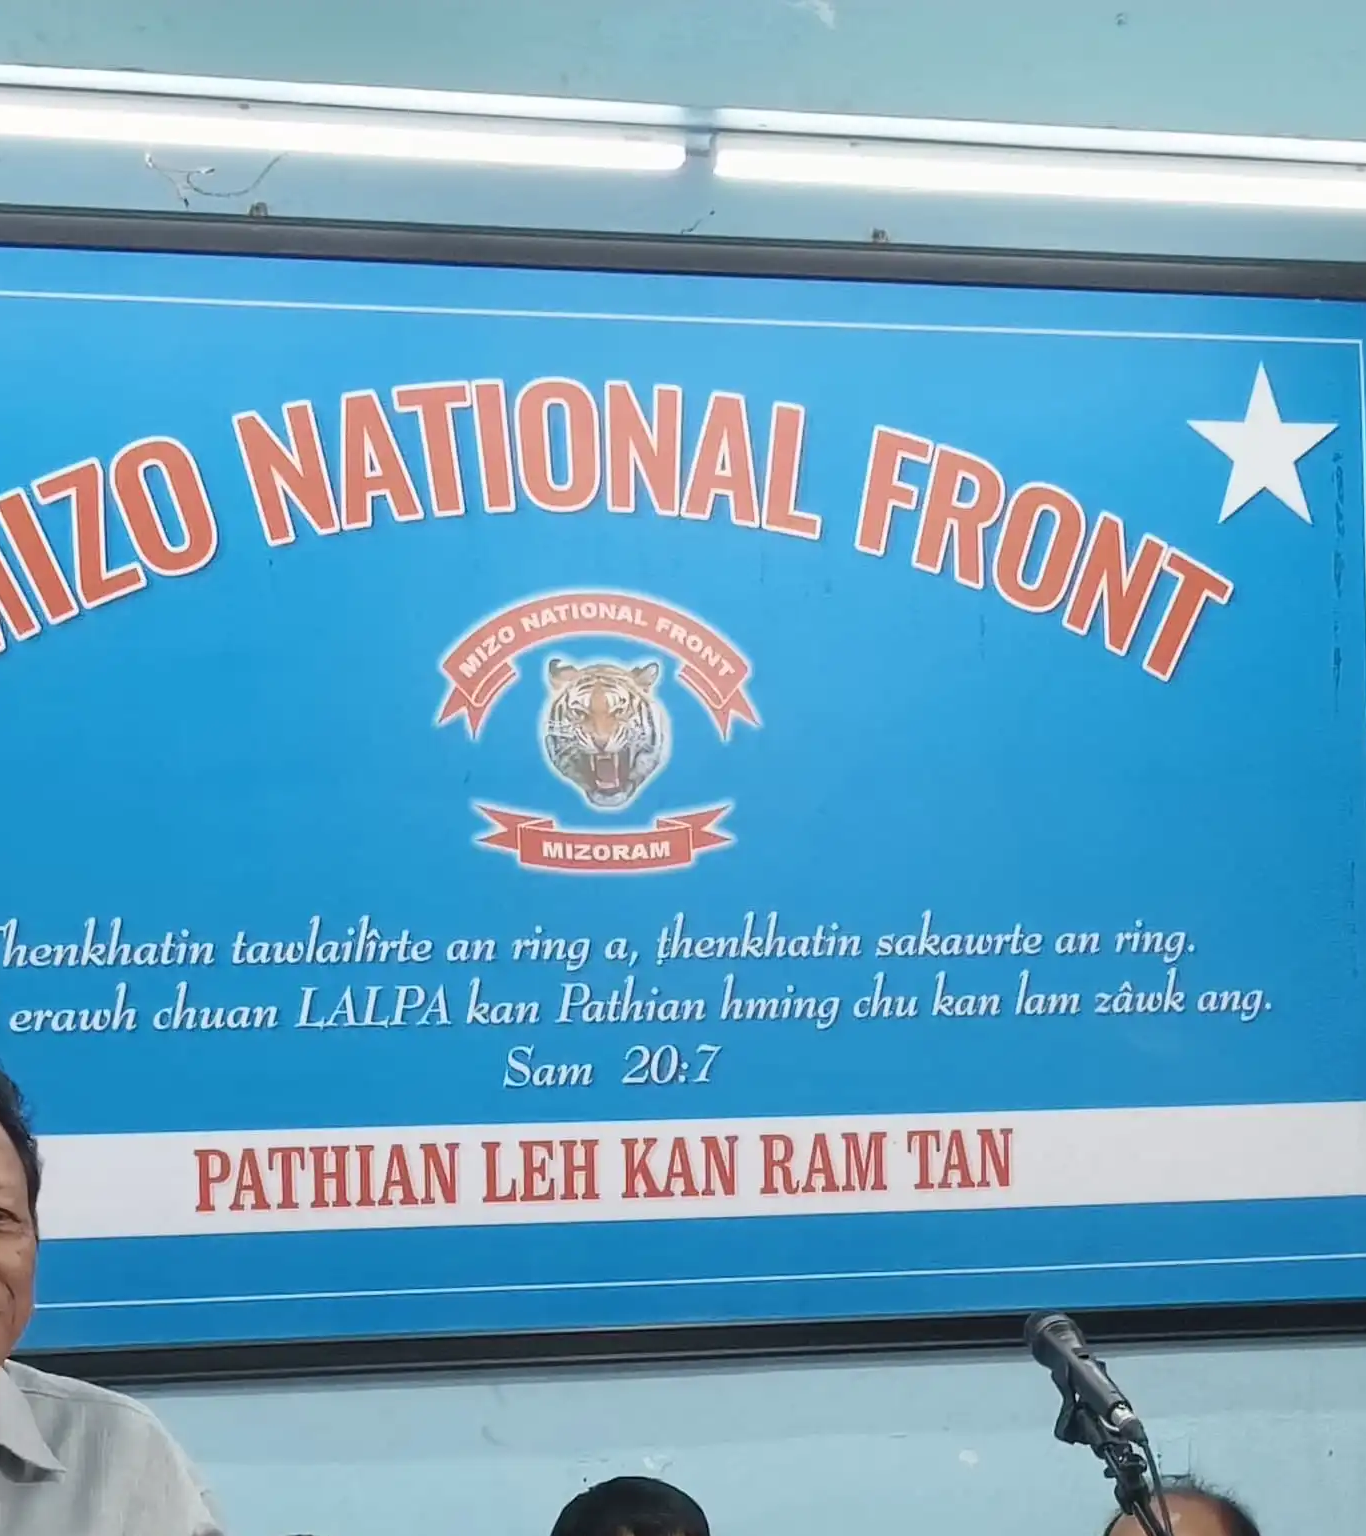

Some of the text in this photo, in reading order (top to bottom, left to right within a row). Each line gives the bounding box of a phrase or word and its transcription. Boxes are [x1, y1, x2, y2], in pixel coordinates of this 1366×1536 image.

[231, 376, 822, 548] NATIONAL
[854, 425, 1234, 683] FRONT
[458, 602, 735, 679] MIZO NATIONAL FRONT
[542, 840, 671, 861] MIZORAM
[446, 938, 496, 962] an
[512, 925, 591, 971] ring
[604, 936, 639, 968] a,
[875, 909, 1042, 957] sakawrte
[1055, 930, 1100, 954] an
[1114, 919, 1196, 963] ring.
[9, 982, 137, 1033] erawh
[153, 981, 278, 1030] chuan
[294, 984, 453, 1030] LALPA
[466, 976, 540, 1025] kan
[555, 975, 706, 1023] Pathian
[720, 973, 840, 1029] hming
[853, 972, 919, 1018] chu
[931, 970, 1001, 1017] kan
[1015, 969, 1080, 1016] lam
[1095, 967, 1184, 1014] zâwk
[1197, 987, 1273, 1021] ang.
[503, 1043, 722, 1087] Sam 20:7
[193, 1126, 1014, 1214] PATHIAN LEH KAN RAM TAN
